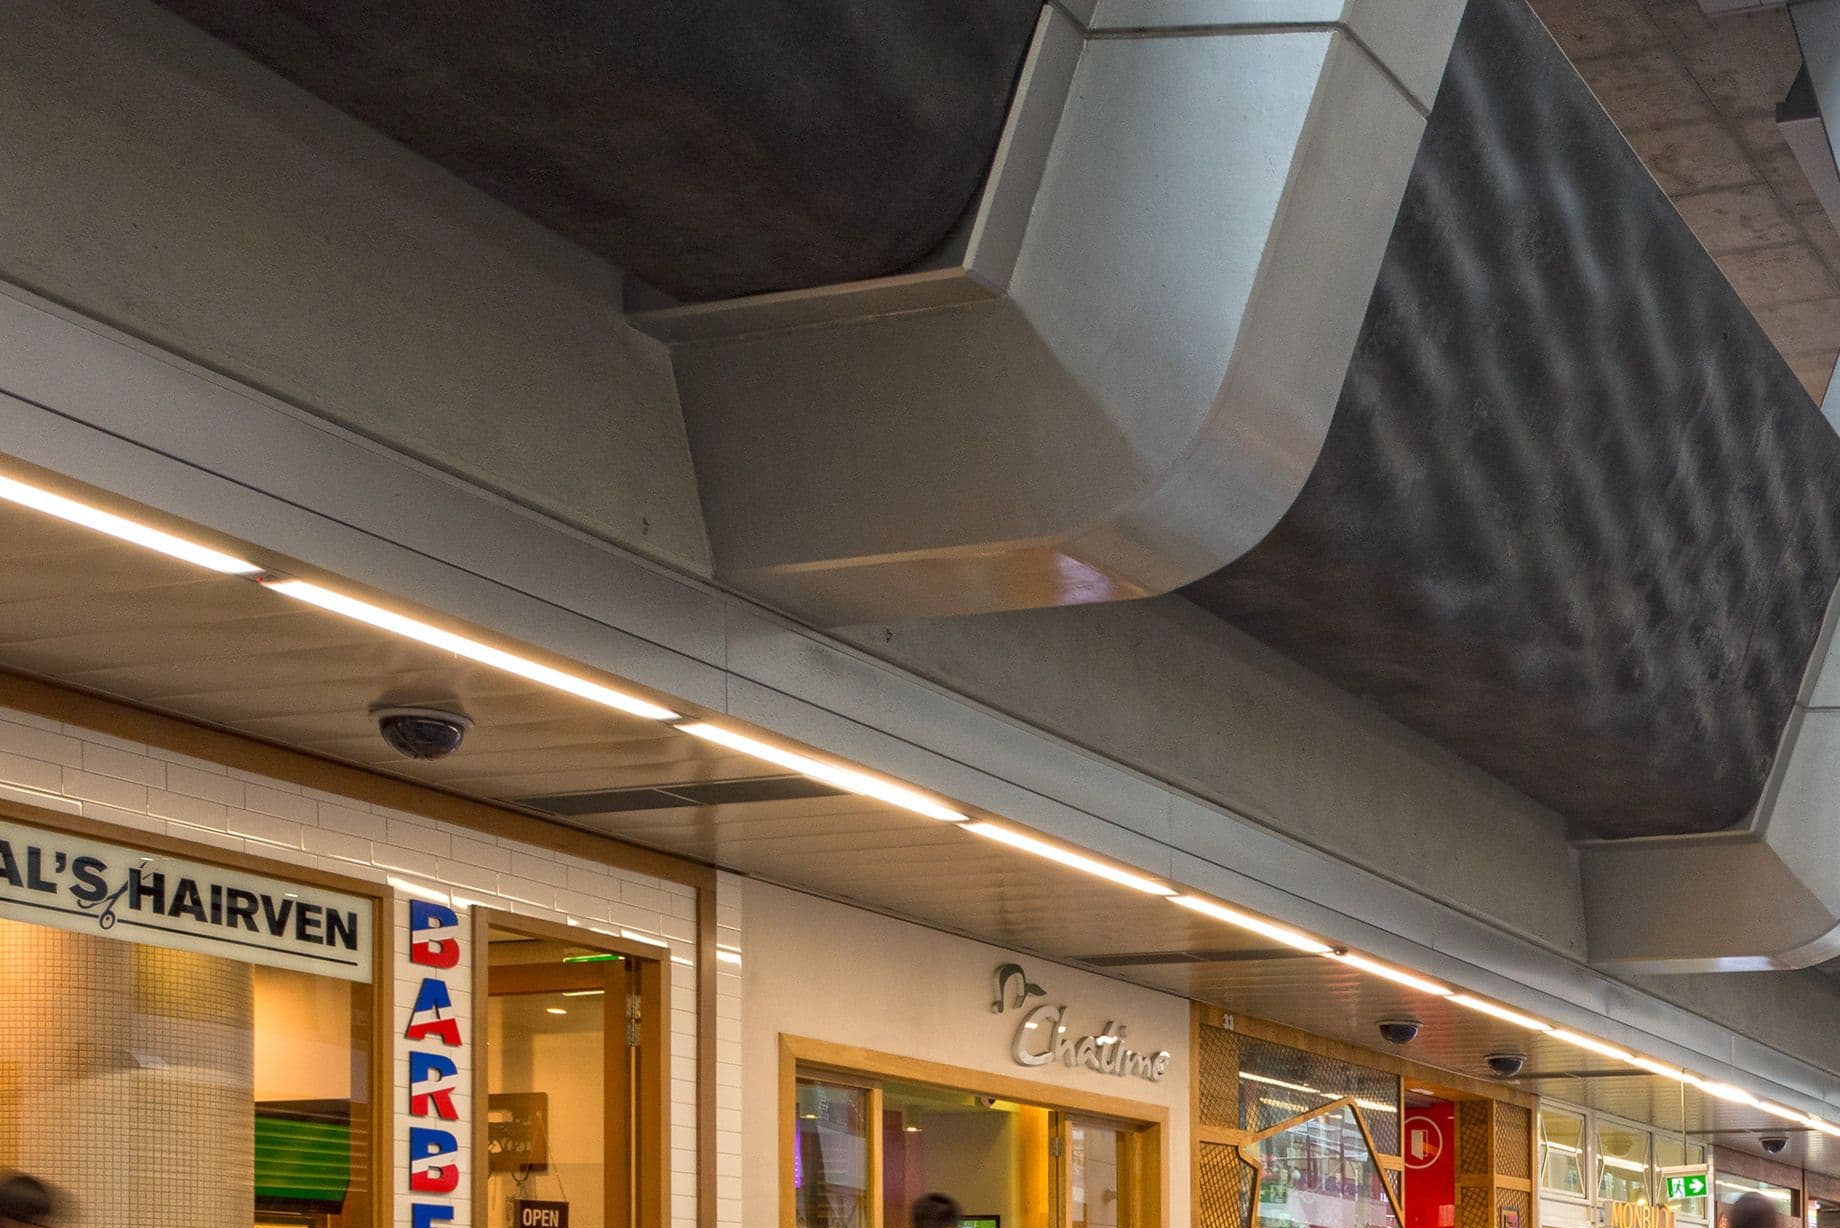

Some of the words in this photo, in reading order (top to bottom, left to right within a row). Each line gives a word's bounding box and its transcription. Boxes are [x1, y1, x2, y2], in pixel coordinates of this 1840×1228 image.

[129, 867, 358, 951] HAIRVEN
[1012, 1005, 1170, 1082] Chatime
[523, 1207, 559, 1227] OPEN
